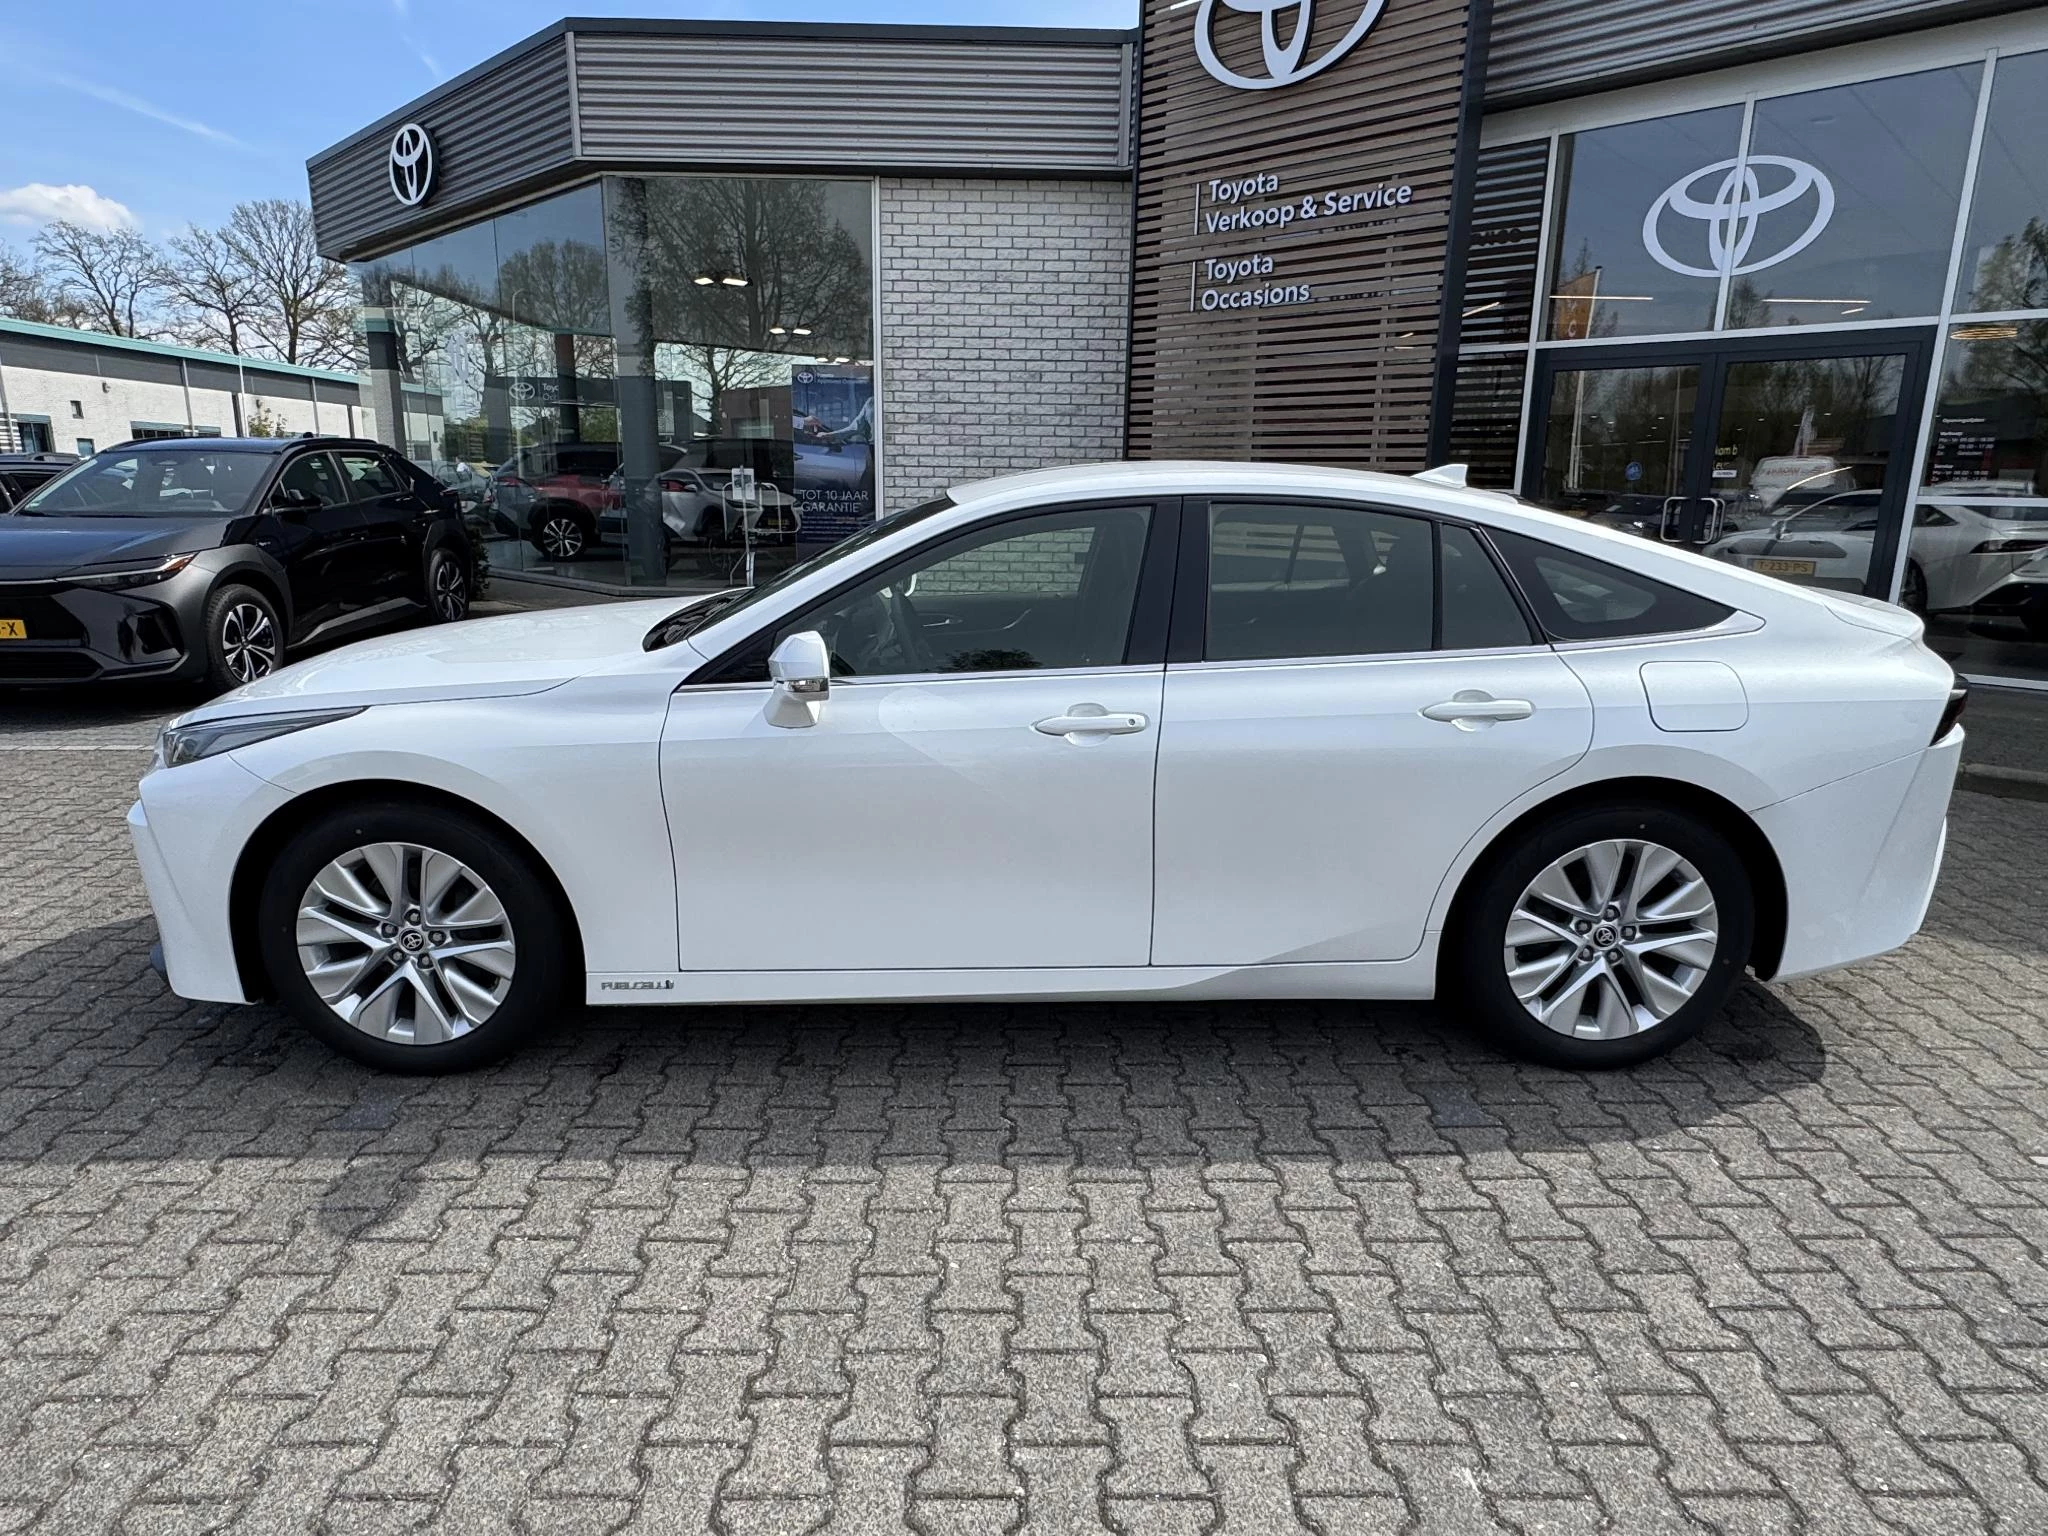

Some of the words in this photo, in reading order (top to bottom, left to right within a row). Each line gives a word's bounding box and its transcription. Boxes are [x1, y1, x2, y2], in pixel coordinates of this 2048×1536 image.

[1209, 172, 1279, 204] Toyota
[1206, 206, 1295, 233] Verkoop
[1300, 195, 1318, 219] &
[1324, 183, 1412, 216] Service
[1205, 254, 1274, 283] Toyota
[1202, 282, 1310, 311] Occasions
[800, 489, 822, 500] TOT
[825, 490, 838, 500] 10
[841, 490, 869, 500] JAAR
[801, 502, 861, 512] GARANTIE
